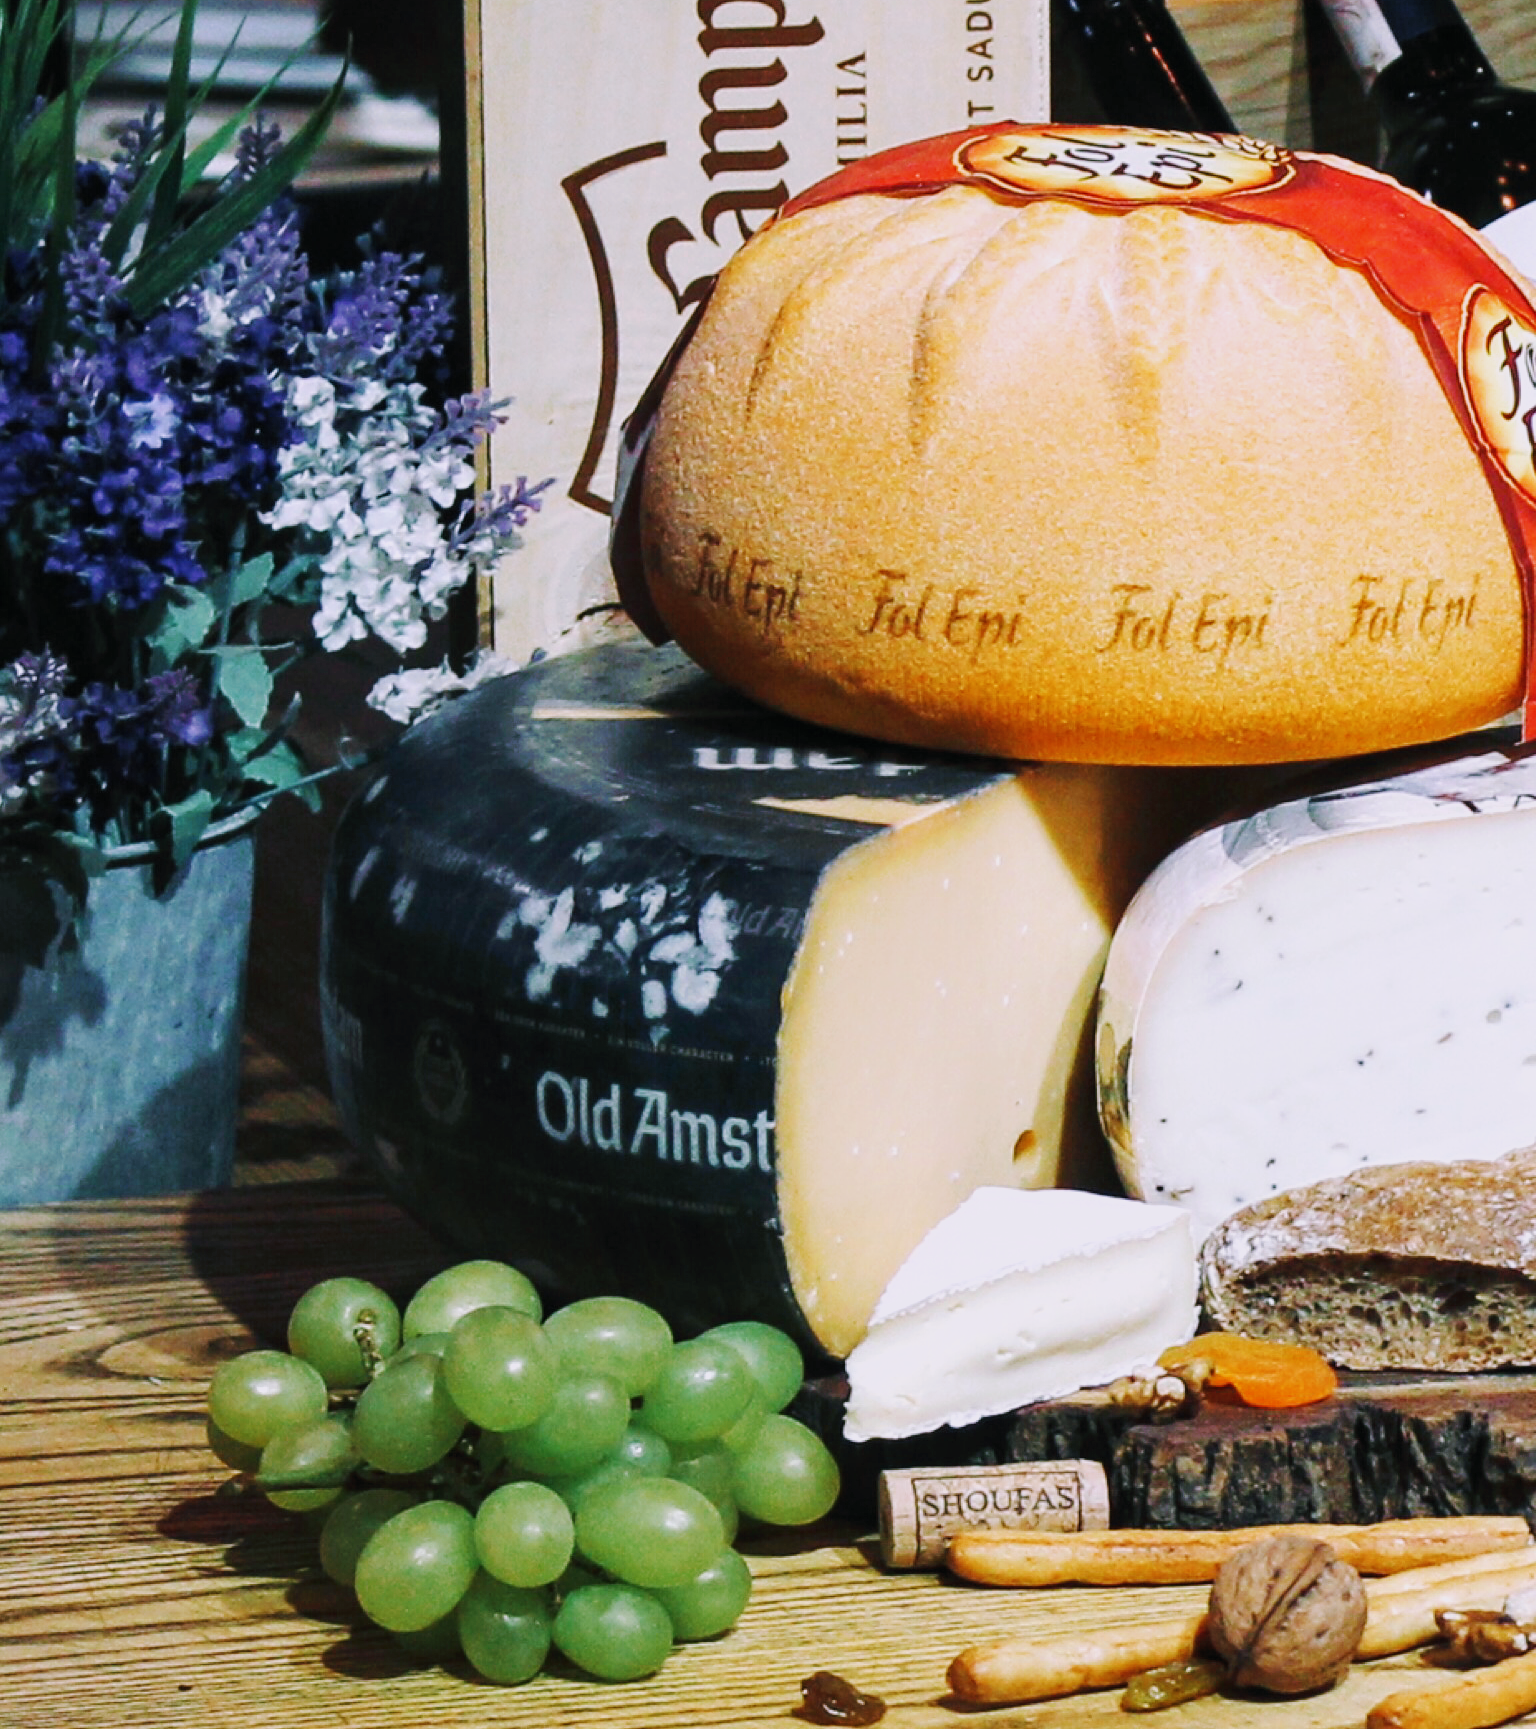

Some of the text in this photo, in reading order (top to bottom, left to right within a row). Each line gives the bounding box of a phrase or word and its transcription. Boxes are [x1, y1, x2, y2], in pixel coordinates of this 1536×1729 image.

[1093, 582, 1275, 673] Fol Epi
[1338, 572, 1482, 655] Fol Epi
[536, 1070, 623, 1152] Old
[921, 1485, 1076, 1517] SHOUFAS
